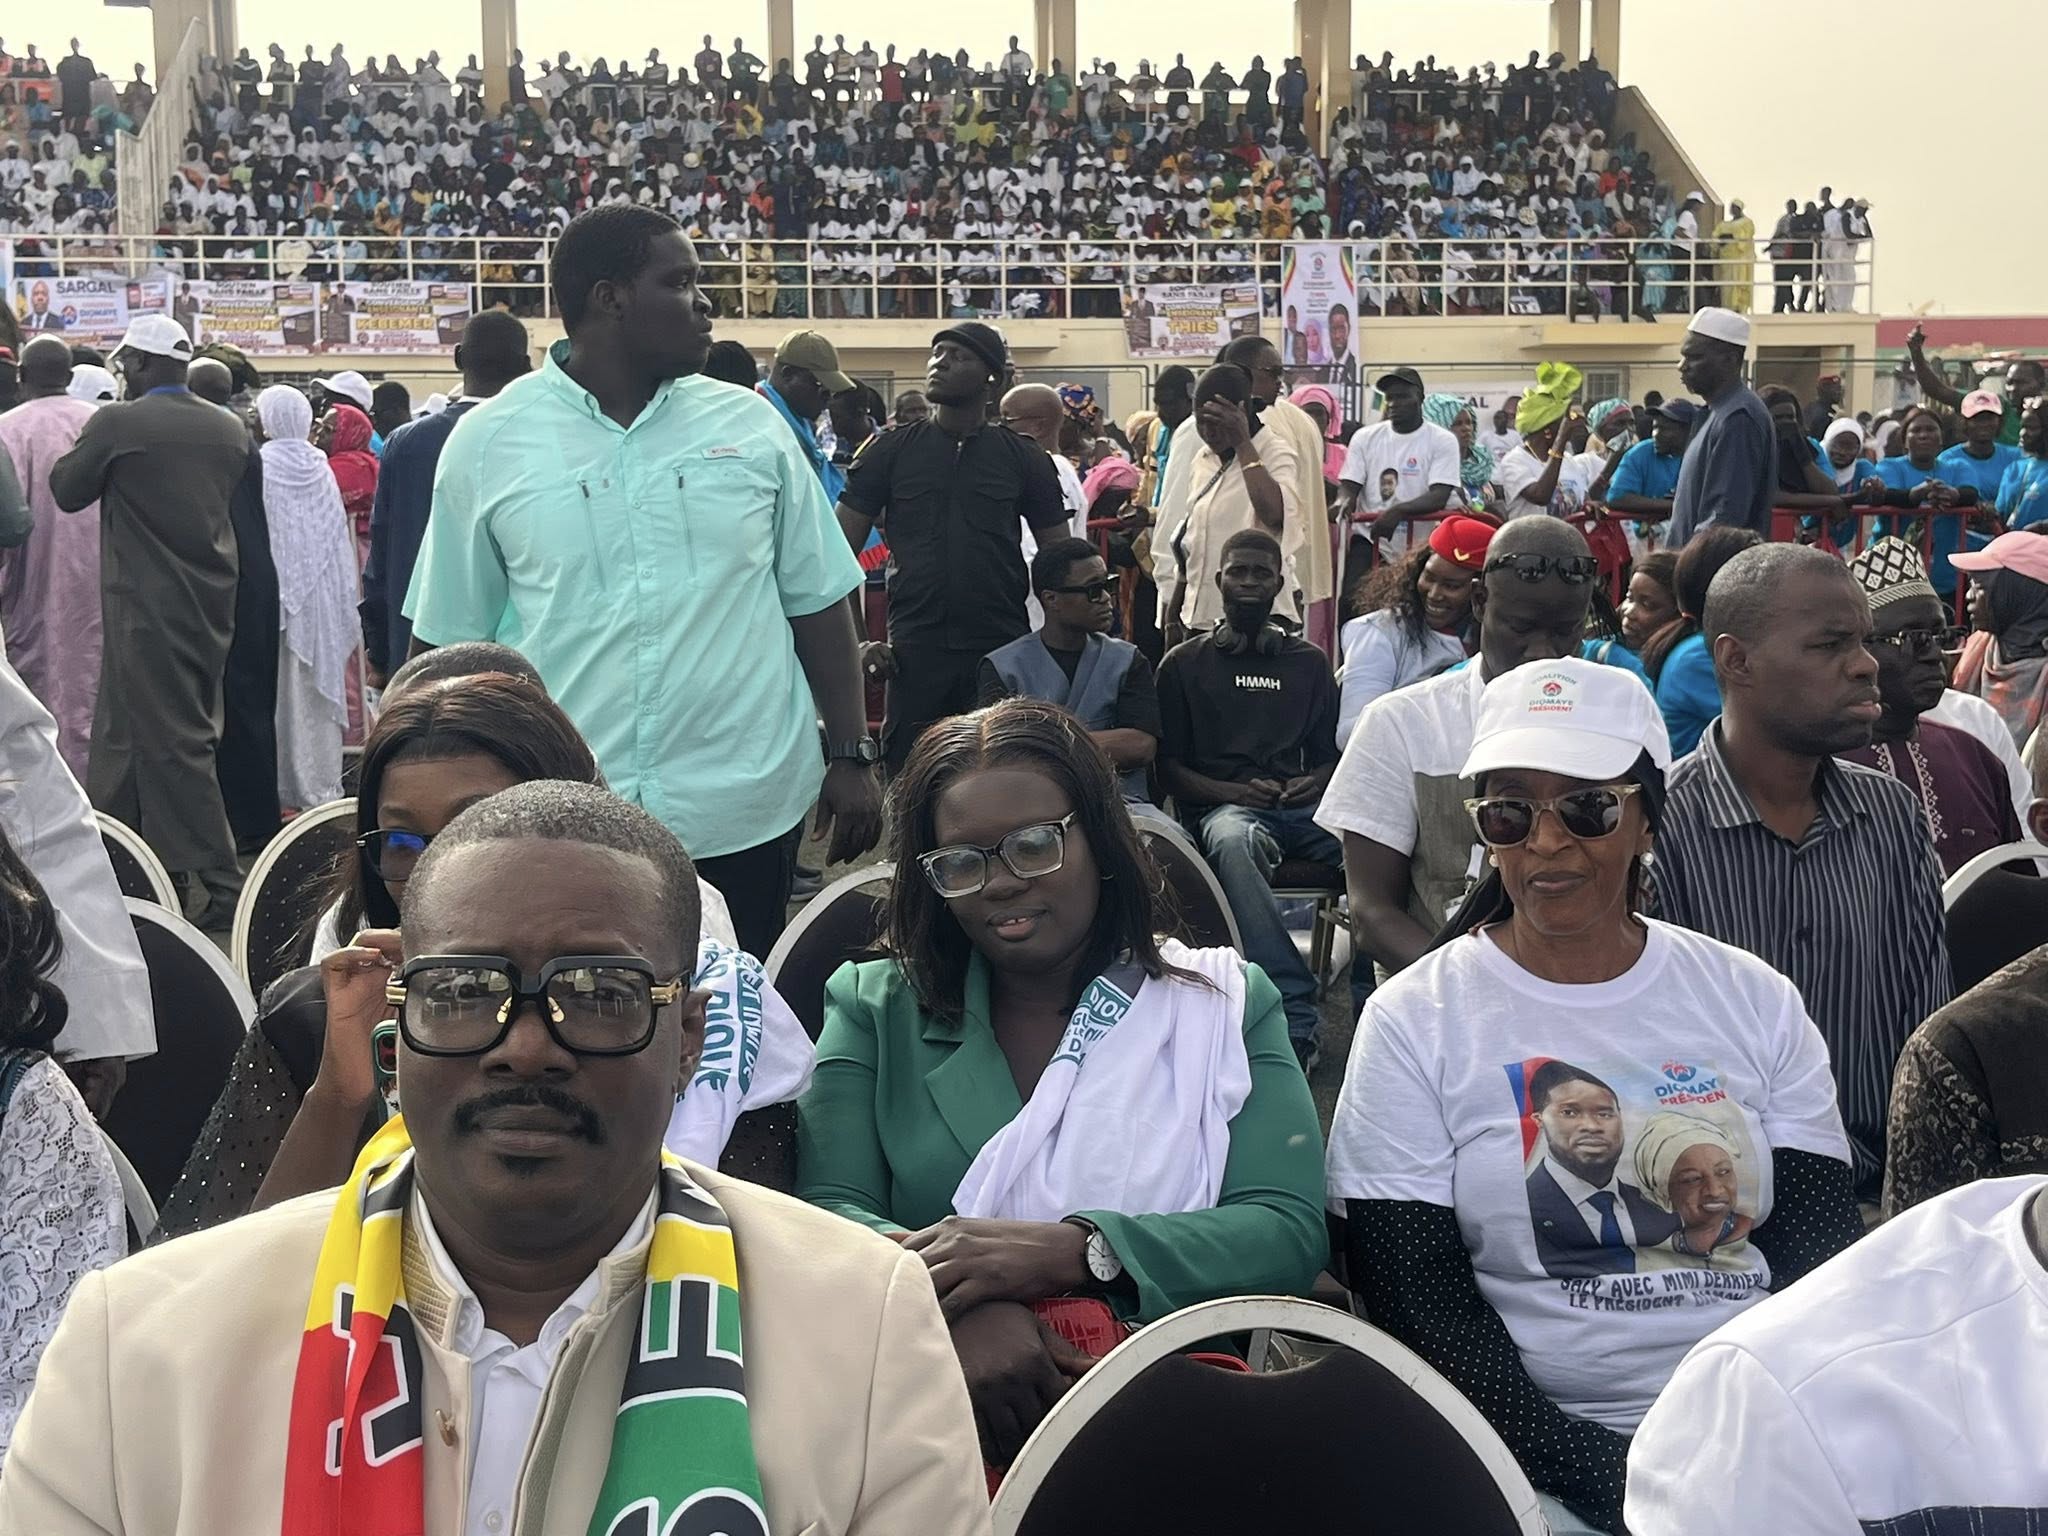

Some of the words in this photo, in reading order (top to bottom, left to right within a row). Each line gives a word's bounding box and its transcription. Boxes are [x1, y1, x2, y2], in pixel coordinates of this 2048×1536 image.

[56, 280, 116, 294] SARGAL
[1167, 321, 1218, 334] THIES
[1235, 675, 1281, 690] HMMH
[1661, 1271, 1700, 1292] MIMI
[1570, 1293, 1589, 1309] LE
